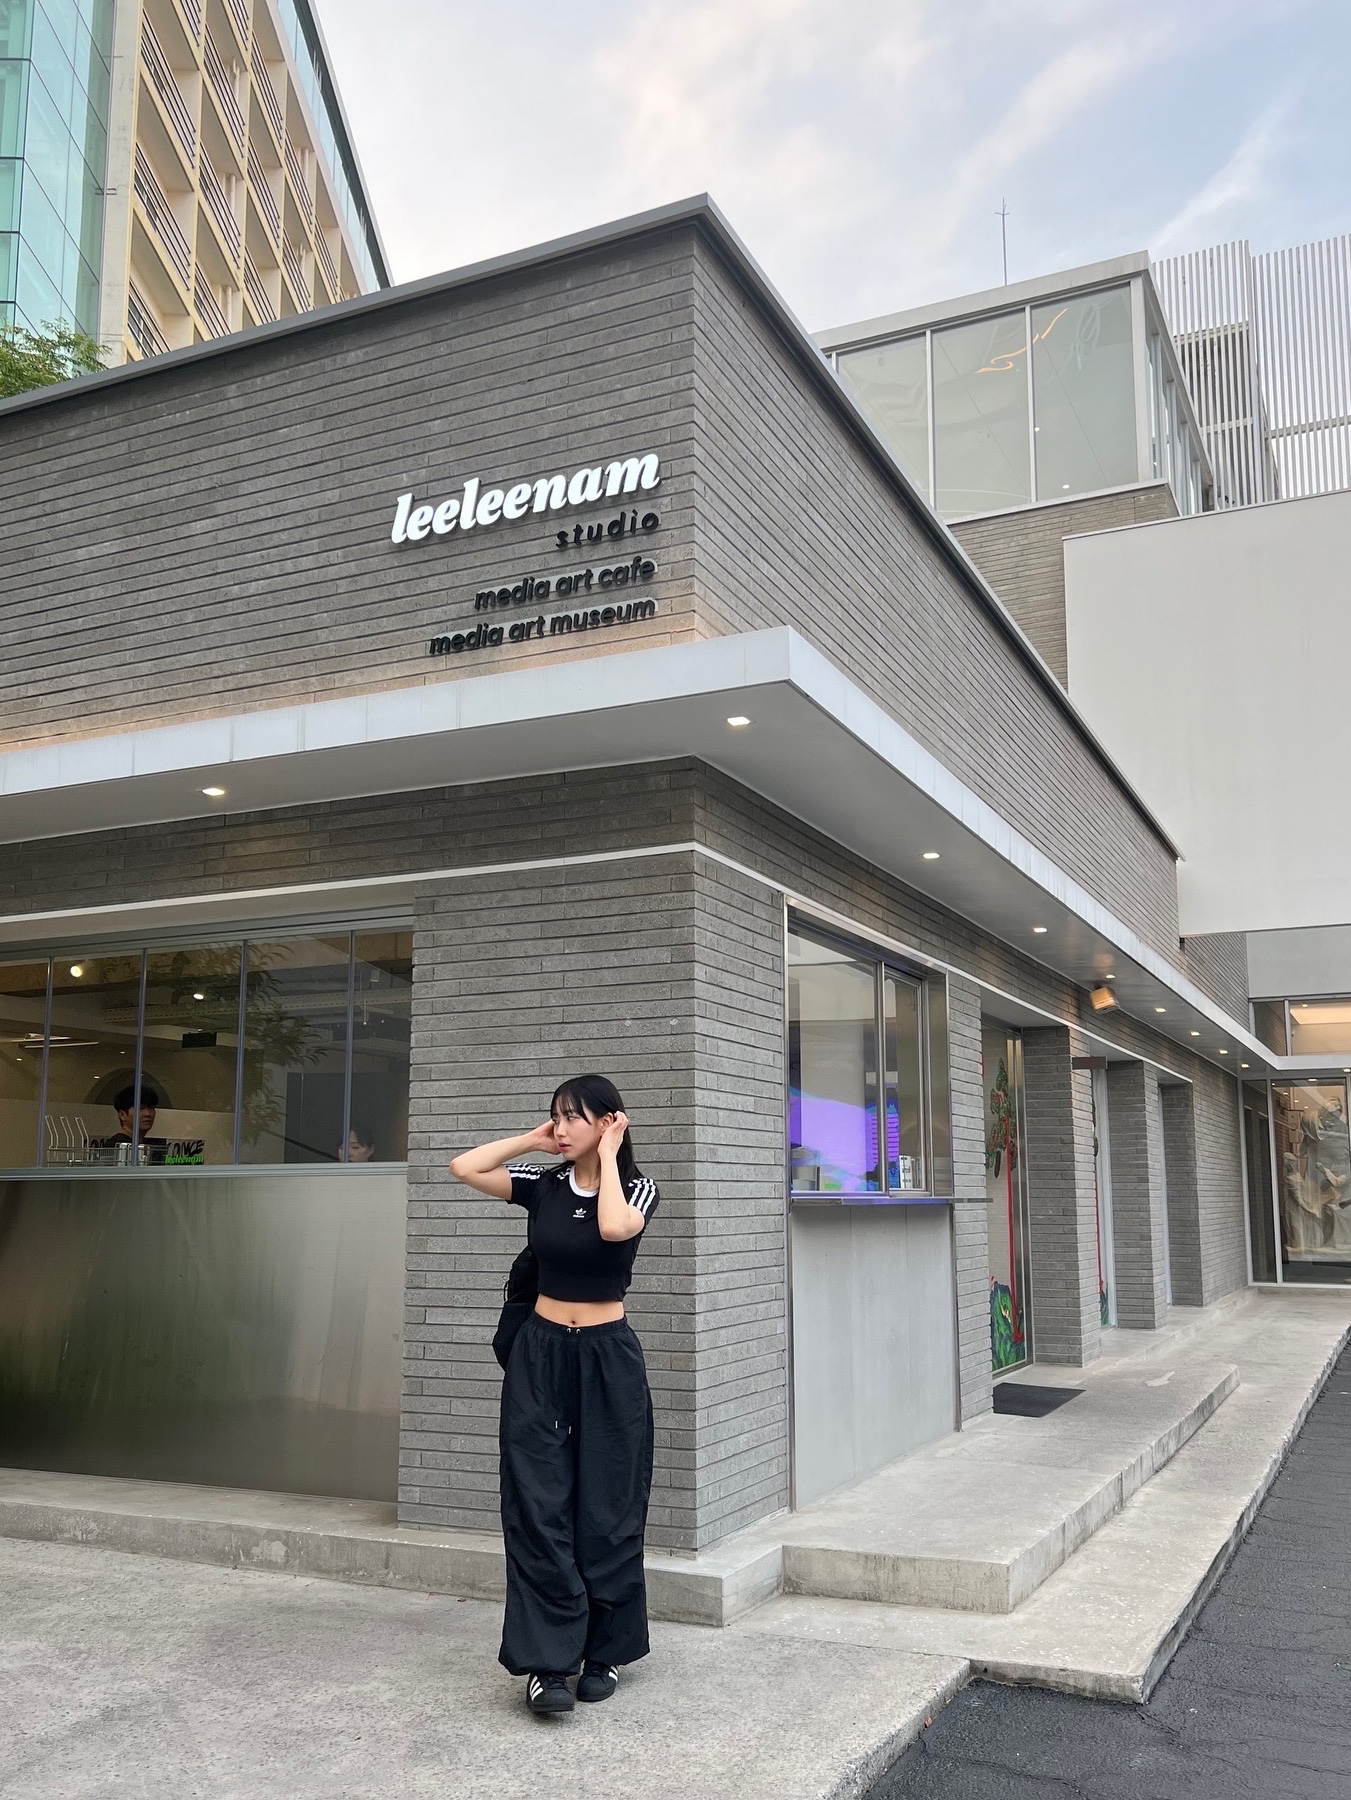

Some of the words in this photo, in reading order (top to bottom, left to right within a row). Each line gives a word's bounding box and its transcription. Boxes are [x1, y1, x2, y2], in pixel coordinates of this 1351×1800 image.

[391, 453, 661, 544] leeleenam
[556, 510, 659, 548] studio
[474, 576, 550, 610] media
[555, 568, 594, 596] art
[598, 556, 655, 588] cafe
[429, 622, 504, 654] media
[508, 615, 545, 642] art
[550, 598, 655, 634] museum
